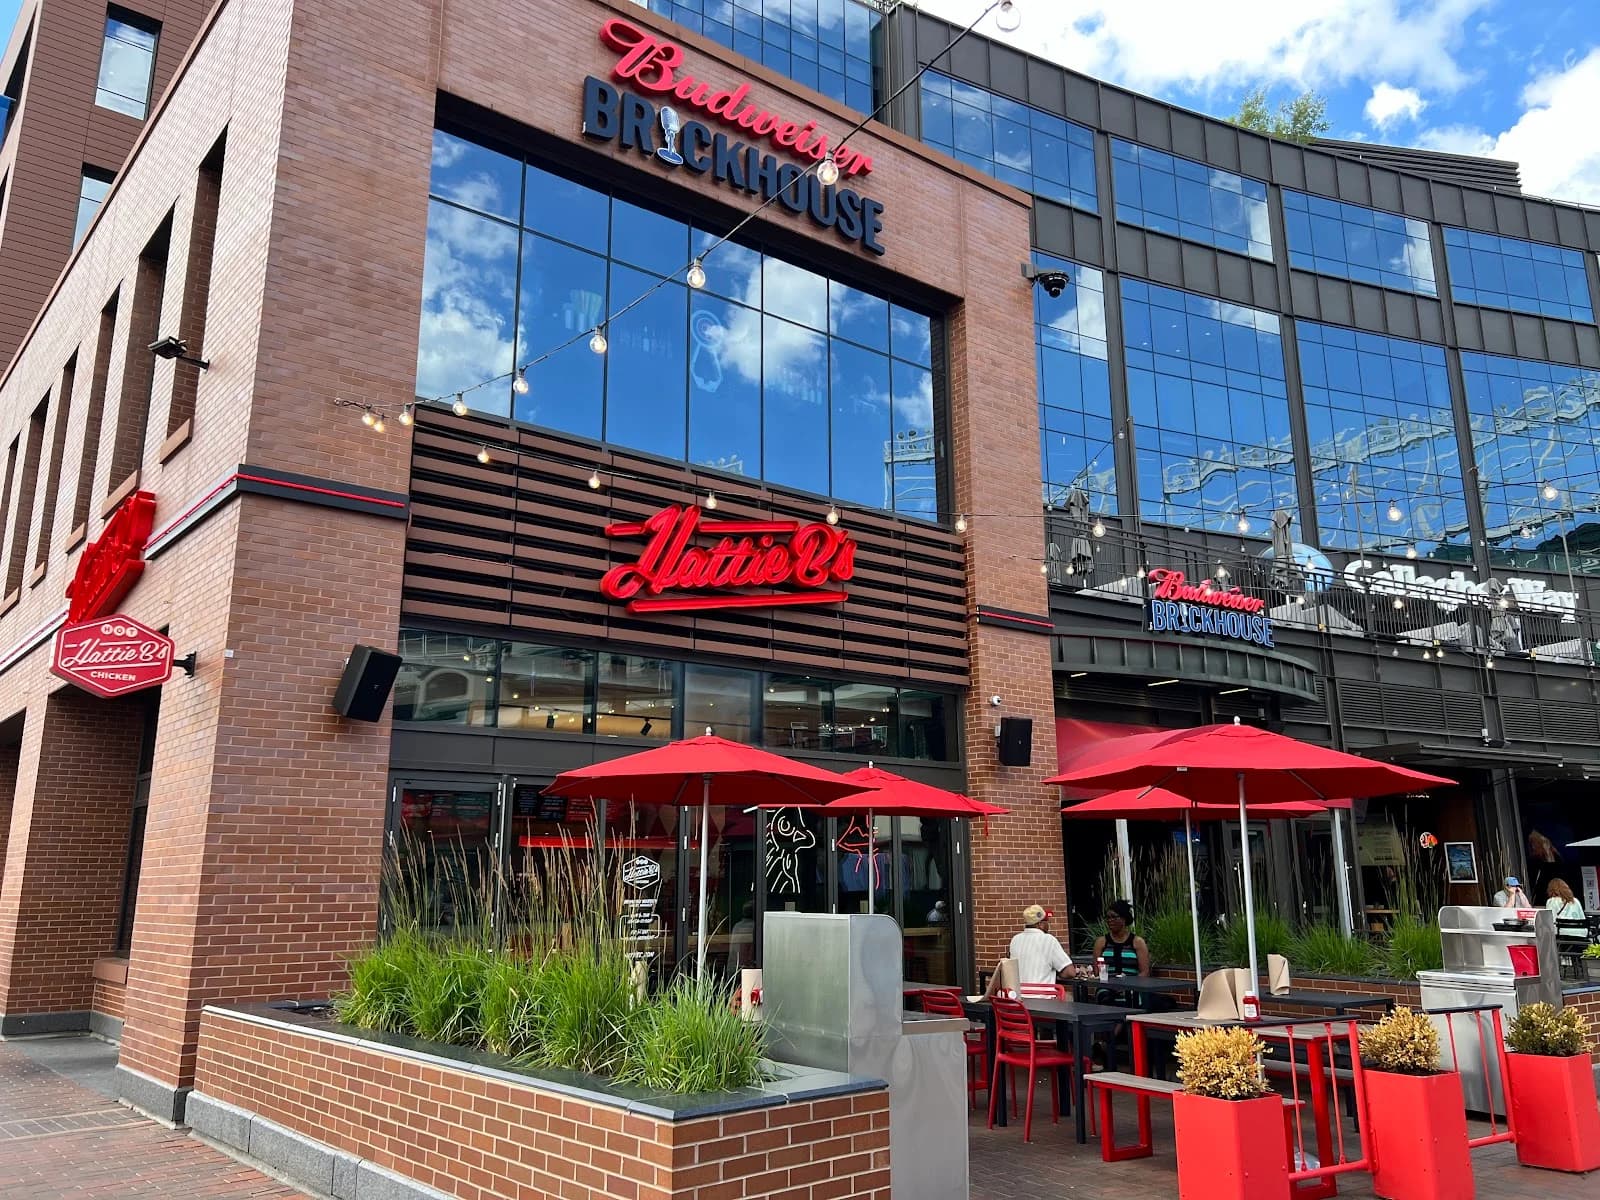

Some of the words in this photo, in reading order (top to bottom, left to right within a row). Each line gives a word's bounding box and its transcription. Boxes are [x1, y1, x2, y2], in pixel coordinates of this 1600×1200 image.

[599, 18, 873, 179] Budweiser
[582, 74, 885, 256] BRICKHOUSE
[600, 503, 793, 600] Hattie
[789, 522, 857, 588] B's
[1148, 568, 1265, 613] Budweiser
[1507, 577, 1580, 624] Way
[102, 624, 138, 637] HOT
[1150, 599, 1275, 648] BRICKHOUSE
[61, 638, 138, 667] Hattie
[140, 641, 169, 661] B's
[90, 671, 137, 681] CHICKEN
